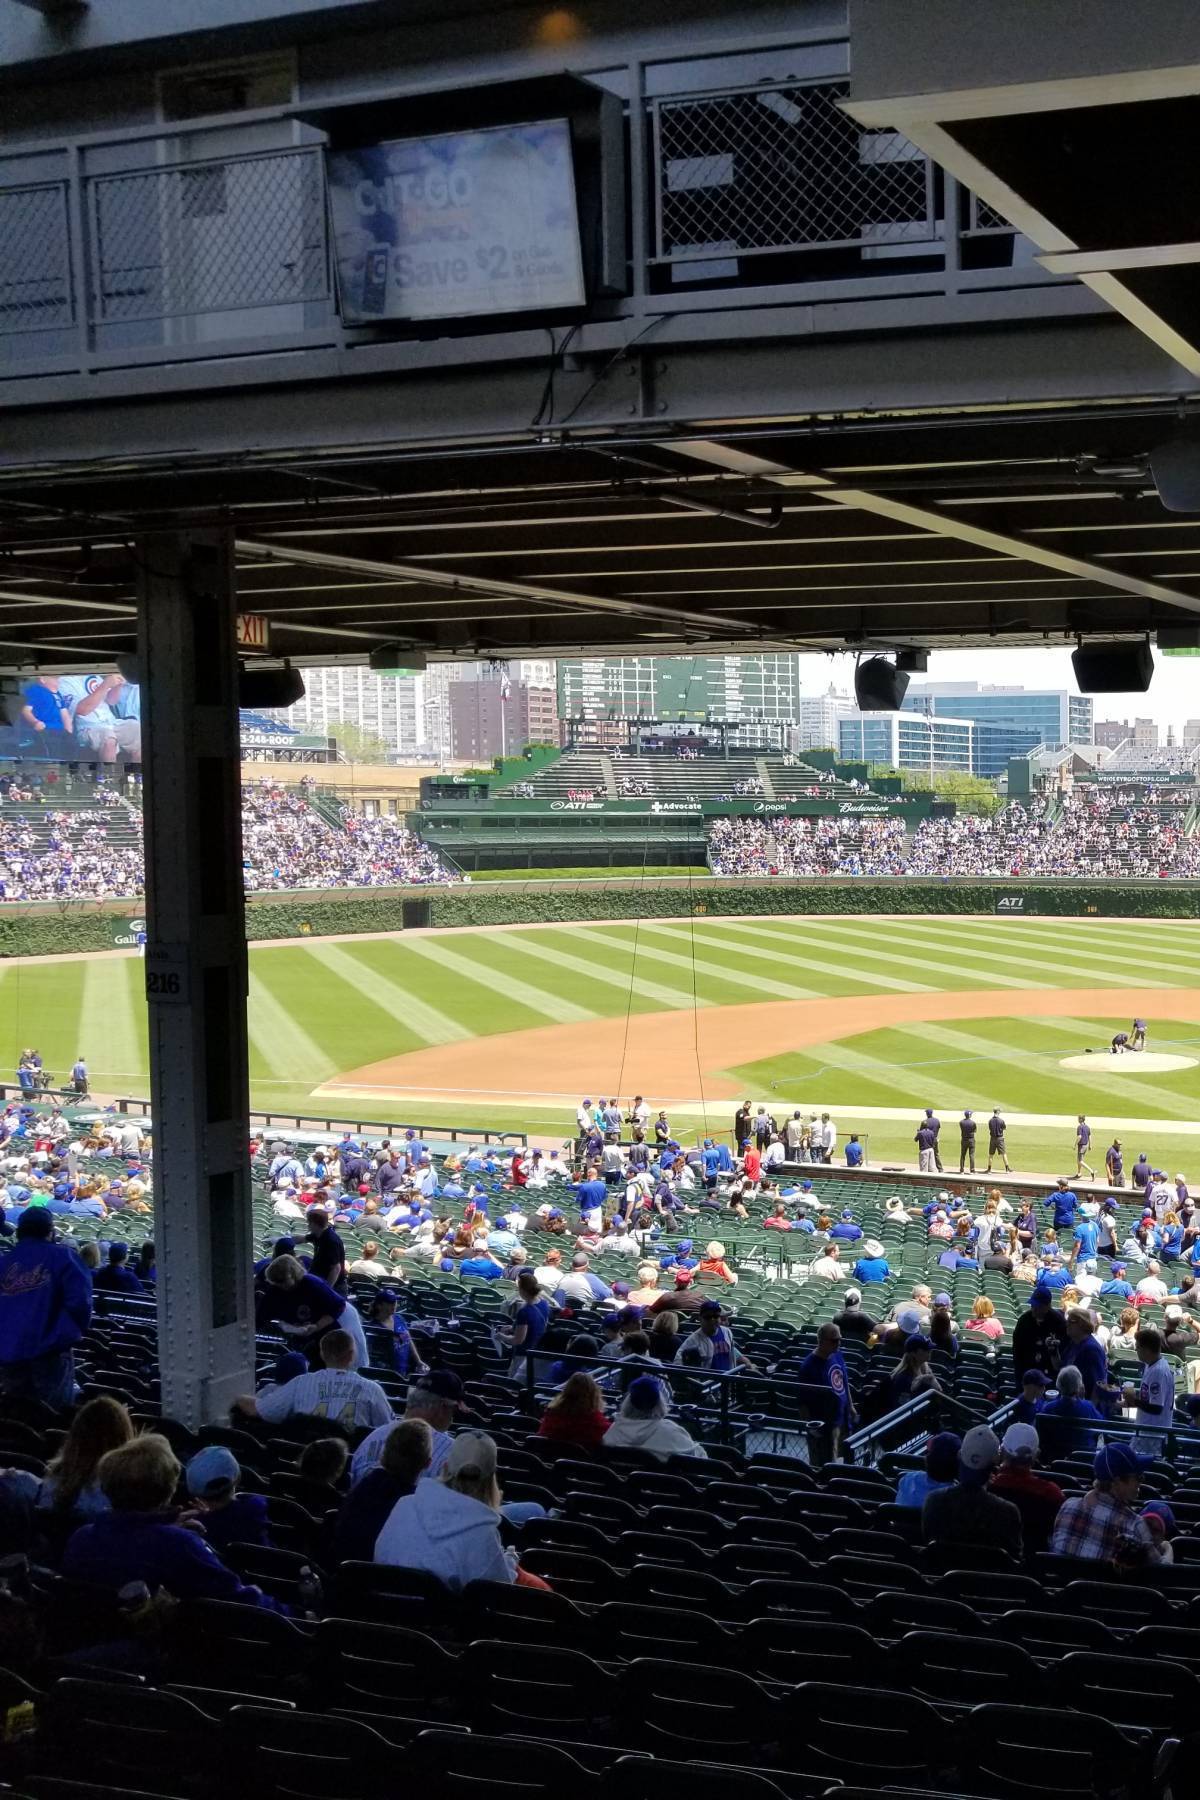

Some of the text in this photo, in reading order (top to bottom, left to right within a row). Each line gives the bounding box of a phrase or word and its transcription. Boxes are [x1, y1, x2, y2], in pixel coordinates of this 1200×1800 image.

[393, 245, 510, 288] Save $2
[838, 803, 889, 812] Budweiser
[998, 898, 1024, 906] ATI
[1156, 1195, 1168, 1205] 27
